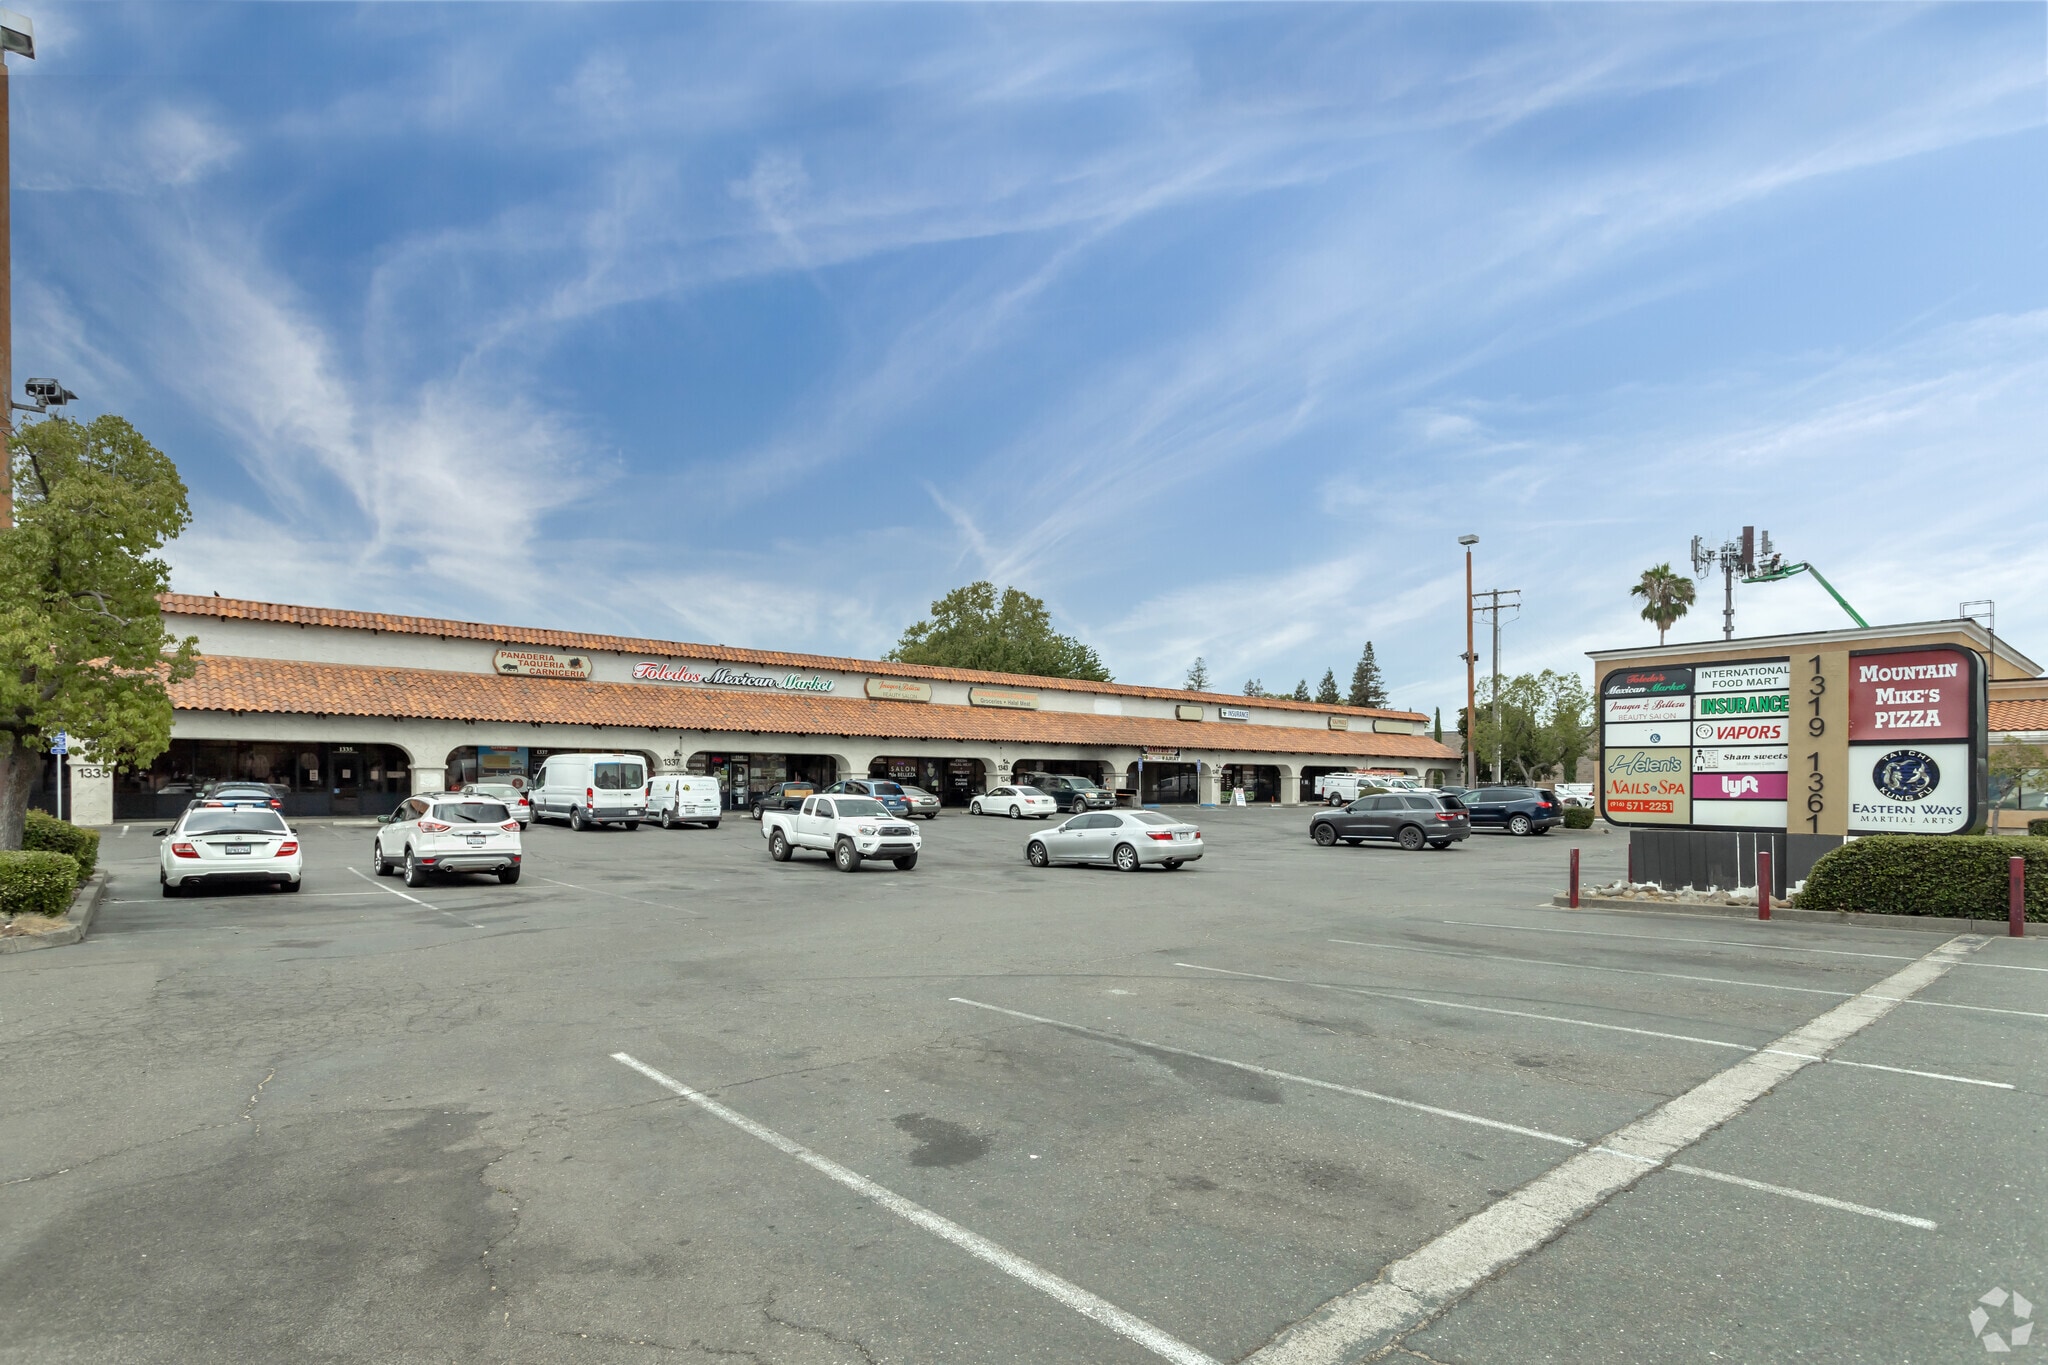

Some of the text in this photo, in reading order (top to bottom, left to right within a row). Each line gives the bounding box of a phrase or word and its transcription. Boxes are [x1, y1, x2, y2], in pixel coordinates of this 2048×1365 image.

[501, 652, 555, 661] PANADERIA
[518, 660, 565, 669] TAQUERIA
[529, 668, 585, 677] CARNICERIA
[632, 661, 834, 692] Toledos Mexican Market
[1701, 666, 1790, 679] INTERNATIONAL
[1859, 663, 1958, 683] MOUNTAIN
[1605, 682, 1687, 695] Mexican Market
[1712, 677, 1779, 688] FOOD MART
[1875, 687, 1940, 705] MIKE'S
[1609, 701, 1641, 713] Imagen
[1651, 699, 1686, 711] Belleza
[1701, 694, 1789, 715] INSURANCE
[1227, 710, 1249, 718] INSURANCE
[1874, 709, 1941, 729] PIZZA
[1717, 725, 1781, 740] VAPORS
[663, 758, 680, 766] 1337
[1608, 751, 1682, 775] Helen's
[1723, 753, 1750, 761] Sham
[1882, 750, 1932, 763] TAI CHI
[1606, 779, 1685, 795] NAILS SPA
[1721, 775, 1759, 798] lyft
[1879, 786, 1934, 801] KUNG FU
[1626, 801, 1673, 811] 571-2251
[1852, 803, 1963, 816] EASTERN WAYS
[1860, 815, 1954, 825] MARTIAL ARTS
